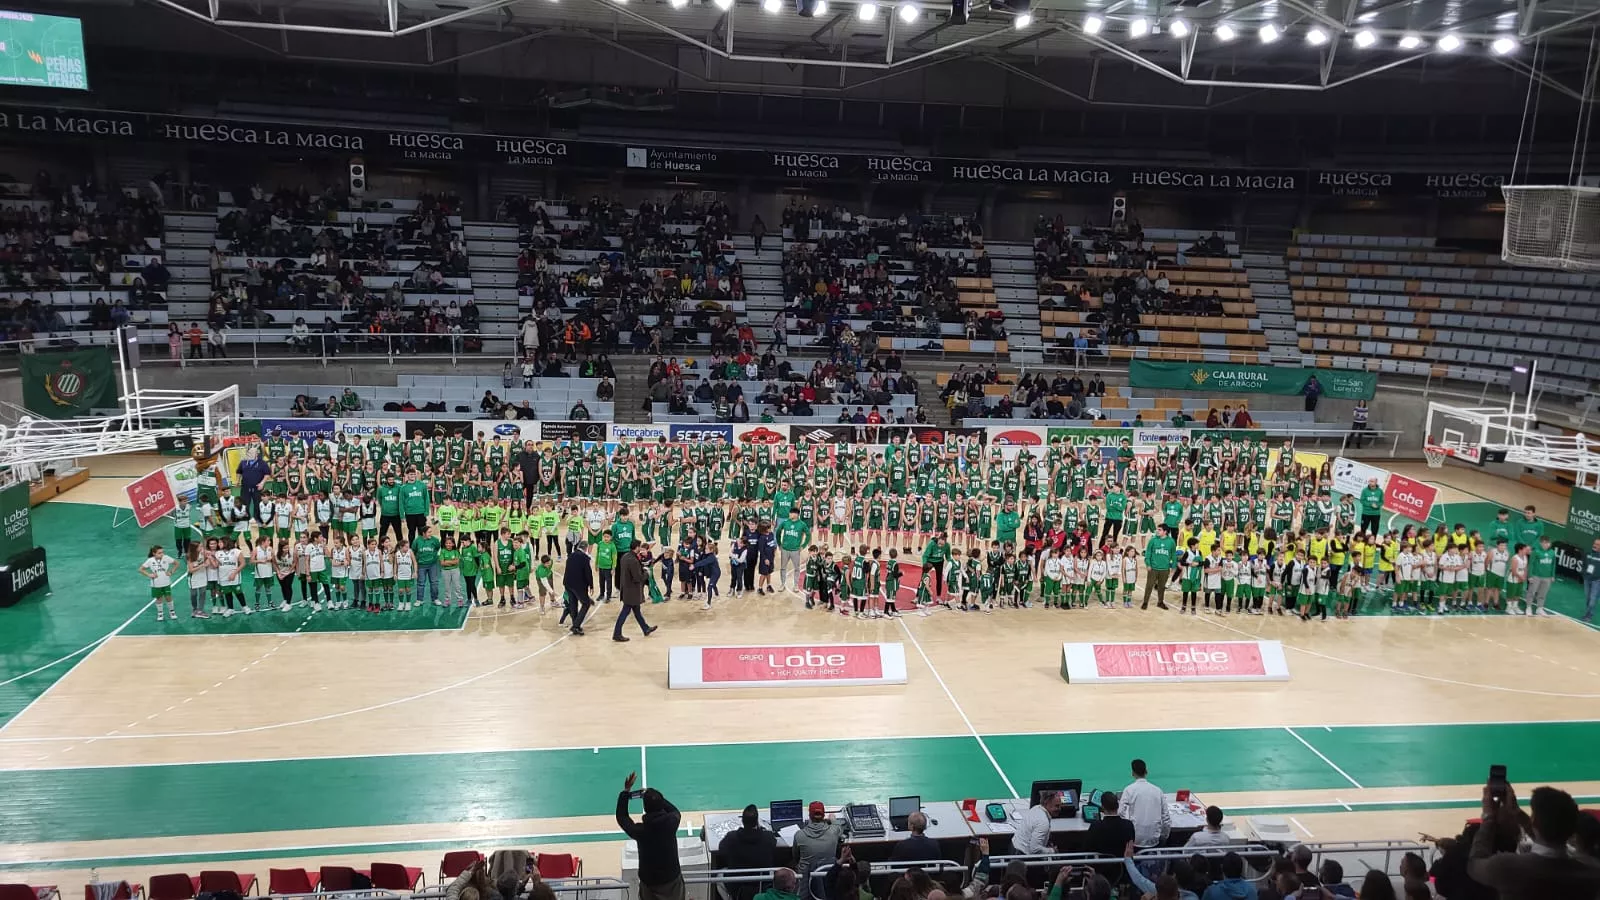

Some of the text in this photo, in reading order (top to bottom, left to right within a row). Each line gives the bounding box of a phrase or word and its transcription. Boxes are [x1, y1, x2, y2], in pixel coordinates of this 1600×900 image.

[650, 151, 717, 162] Ayuntamiento
[665, 162, 701, 171] Huesca
[1212, 370, 1269, 381] CAJA RURAL
[1347, 379, 1363, 387] San
[138, 489, 165, 510] Lobe
[1392, 488, 1424, 508] Lobe
[4, 507, 29, 526] Lobe
[1554, 546, 1583, 573] Hues
[12, 560, 45, 592] Huesca
[768, 650, 846, 668] Lobe
[1155, 647, 1229, 664] Lobe
[793, 669, 817, 677] QUALITY
